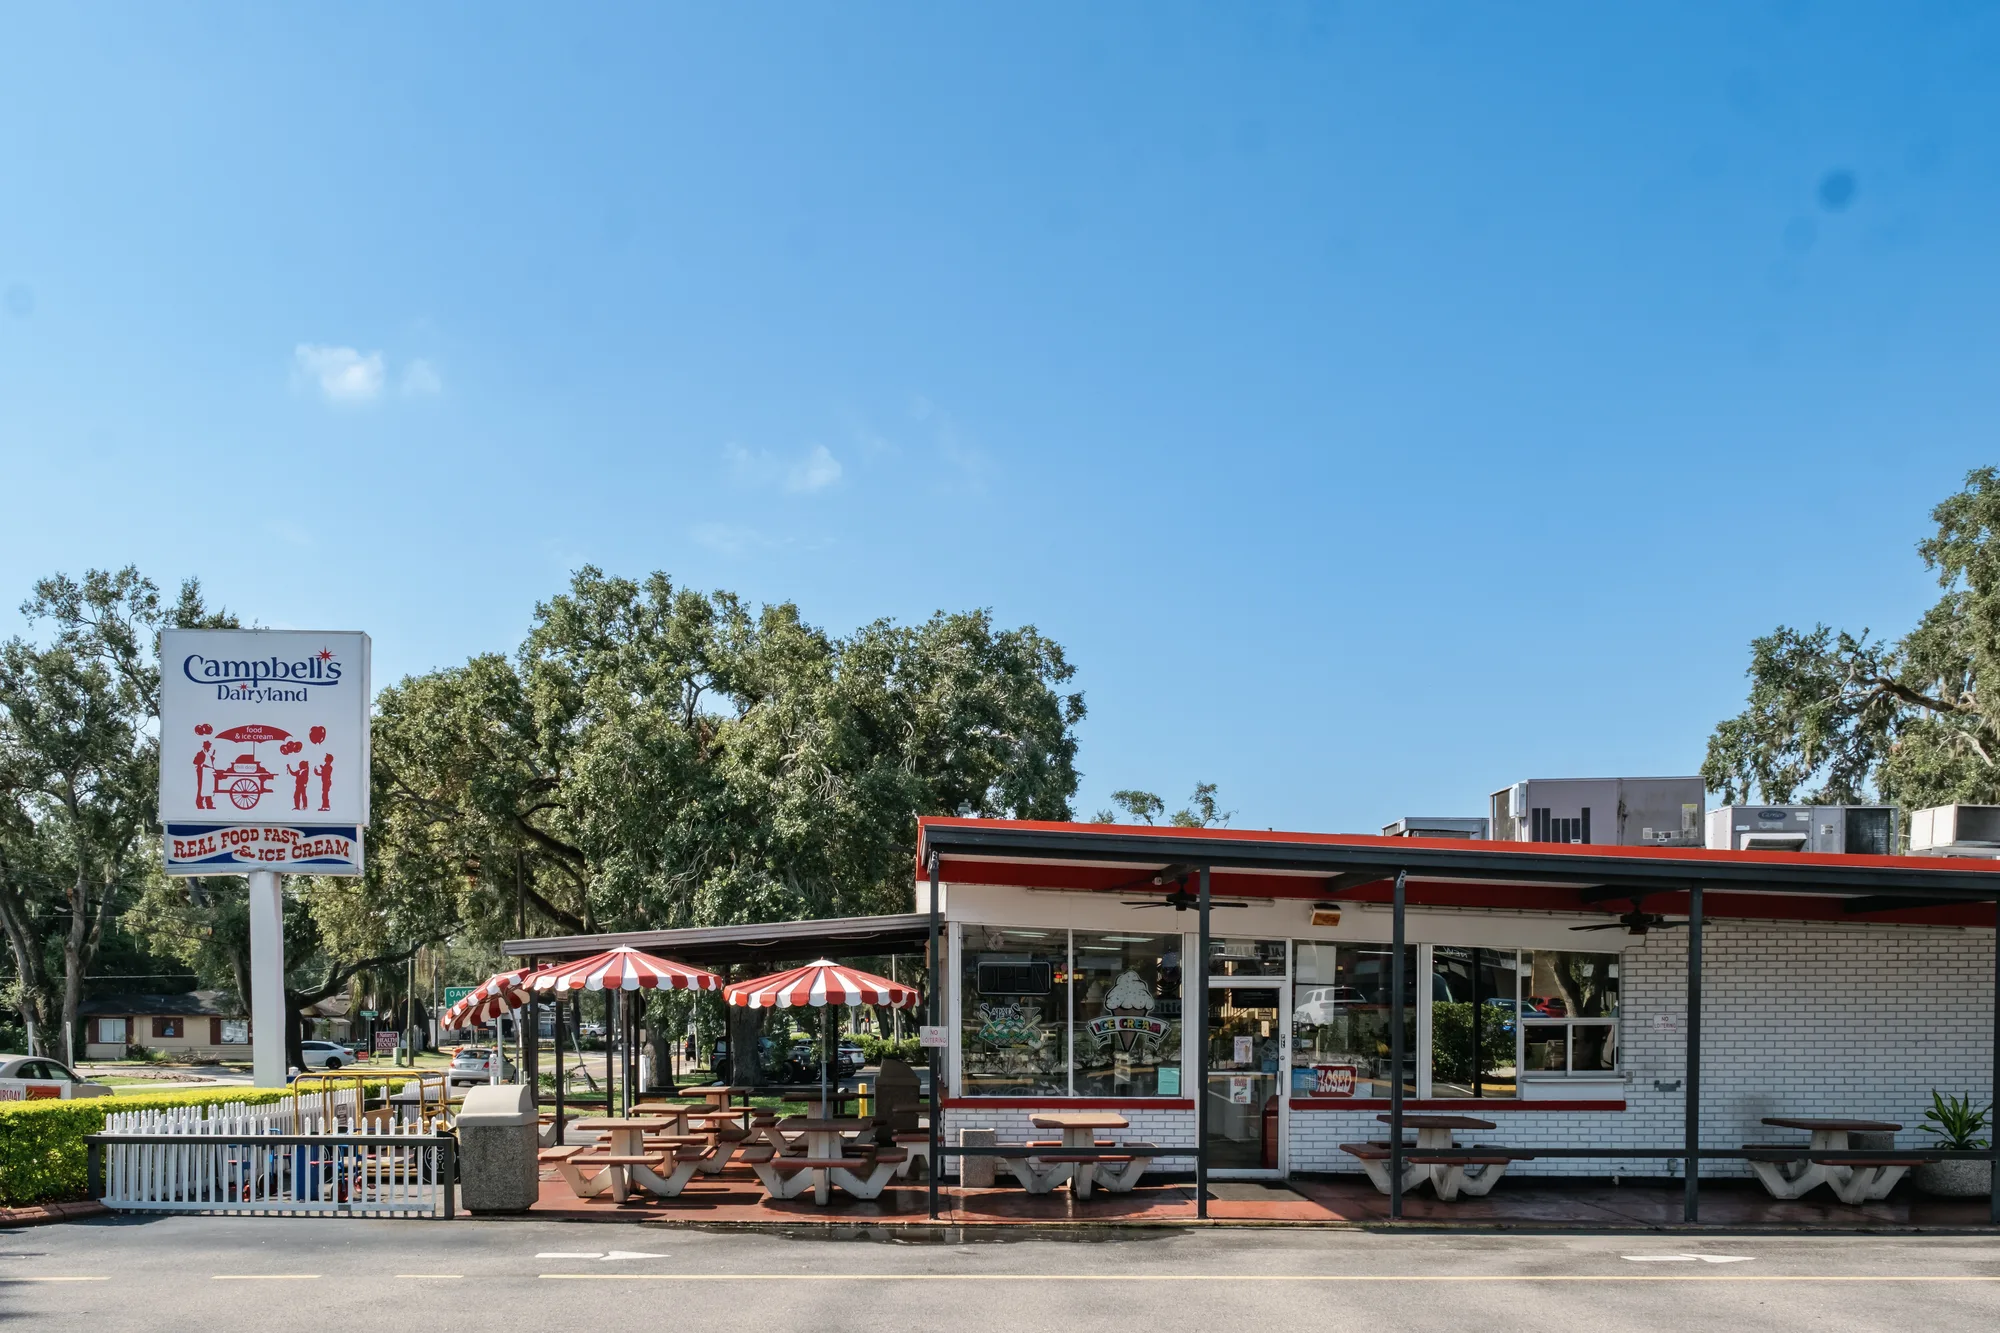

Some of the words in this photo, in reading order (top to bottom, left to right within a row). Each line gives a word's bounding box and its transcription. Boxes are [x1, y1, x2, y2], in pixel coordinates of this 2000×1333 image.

[183, 654, 342, 687] Campbell's
[217, 684, 308, 703] Dairyland
[246, 726, 263, 734] food
[173, 835, 217, 858] REAL
[221, 828, 260, 849] FOOD
[263, 828, 300, 845] FAST
[233, 845, 256, 859] &
[258, 848, 286, 861] ICE
[291, 839, 350, 859] CREAM
[1094, 1019, 1116, 1033] ICE
[1119, 1018, 1161, 1034] CREAM
